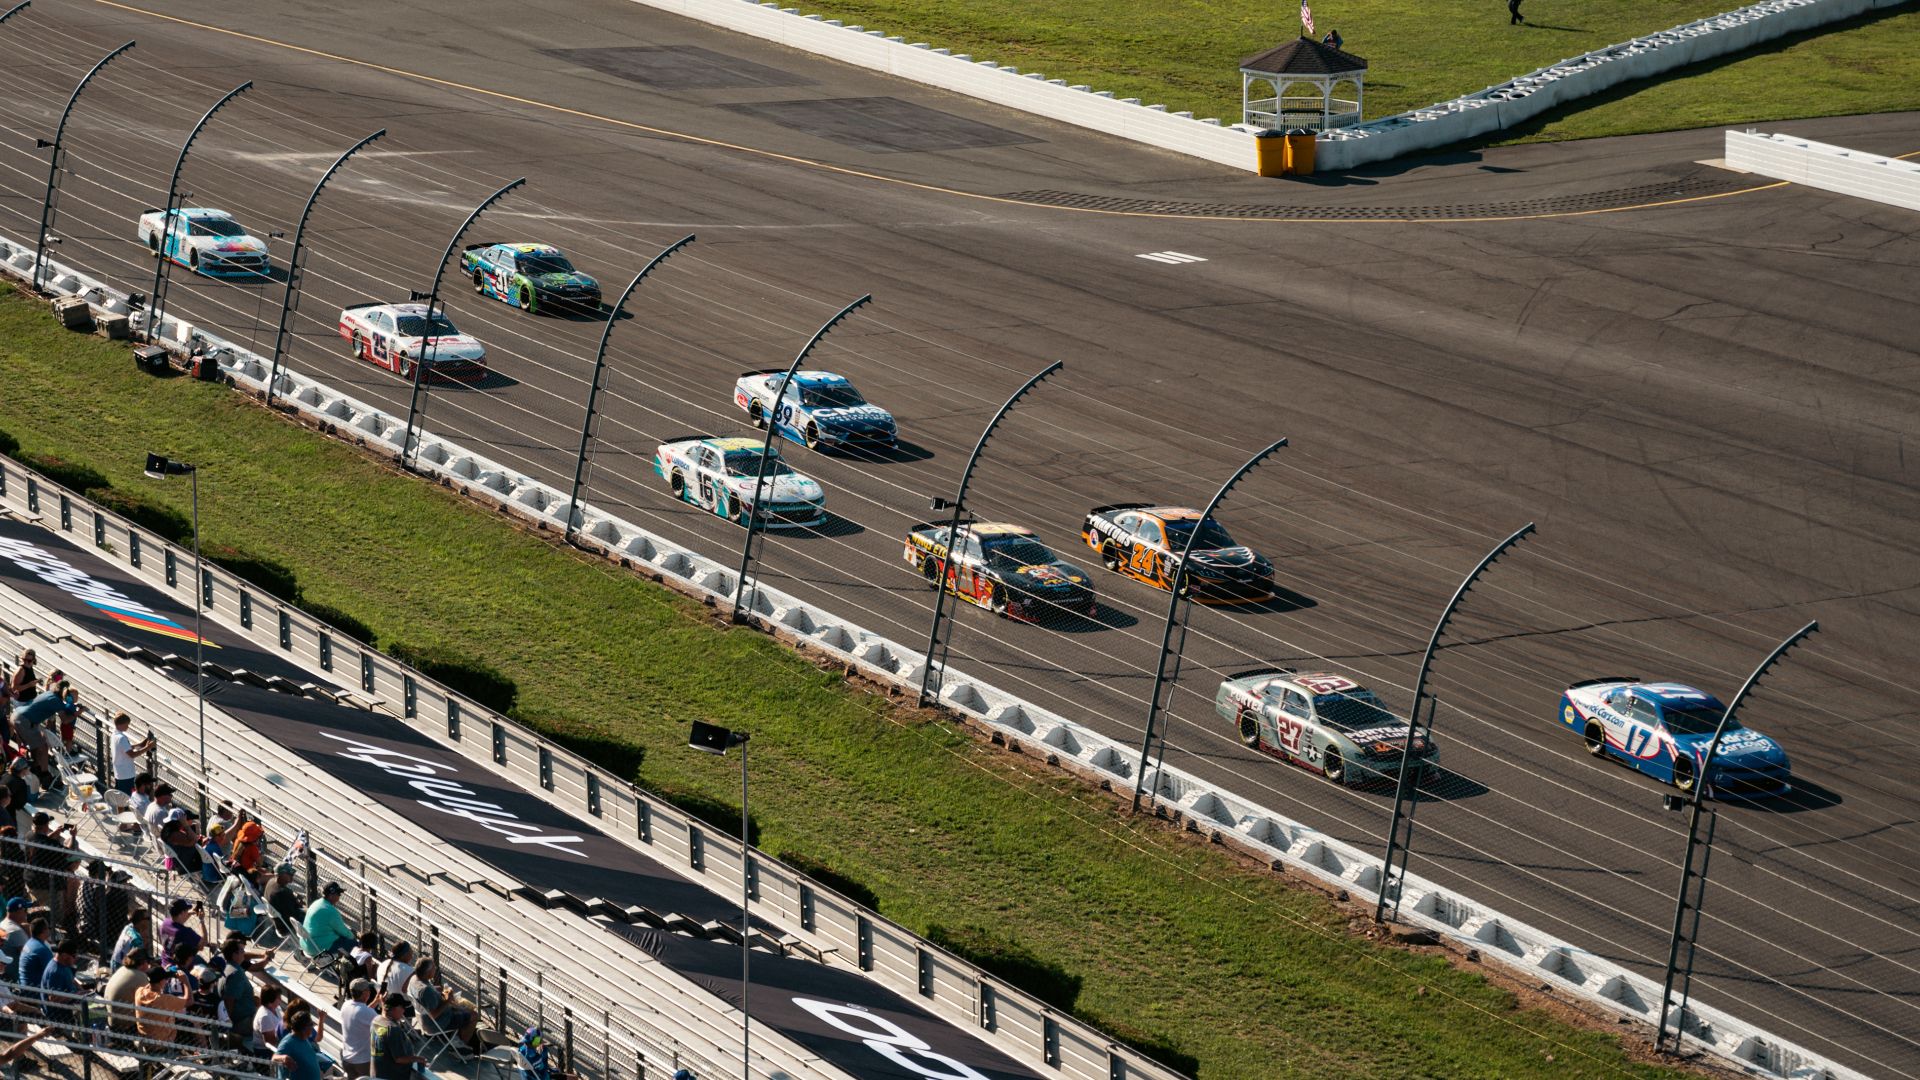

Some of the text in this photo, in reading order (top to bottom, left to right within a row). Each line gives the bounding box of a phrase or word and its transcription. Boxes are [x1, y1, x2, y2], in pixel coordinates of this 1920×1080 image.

[495, 268, 508, 294] 31
[373, 332, 388, 361] 25
[775, 402, 793, 426] 89
[697, 470, 713, 502] 16
[1090, 515, 1131, 547] PHANTOMS
[1130, 542, 1157, 576] 24
[1574, 698, 1625, 728] HickCars.com
[1278, 715, 1303, 751] 27
[1625, 724, 1652, 757] 17
[791, 997, 991, 1080] CO
